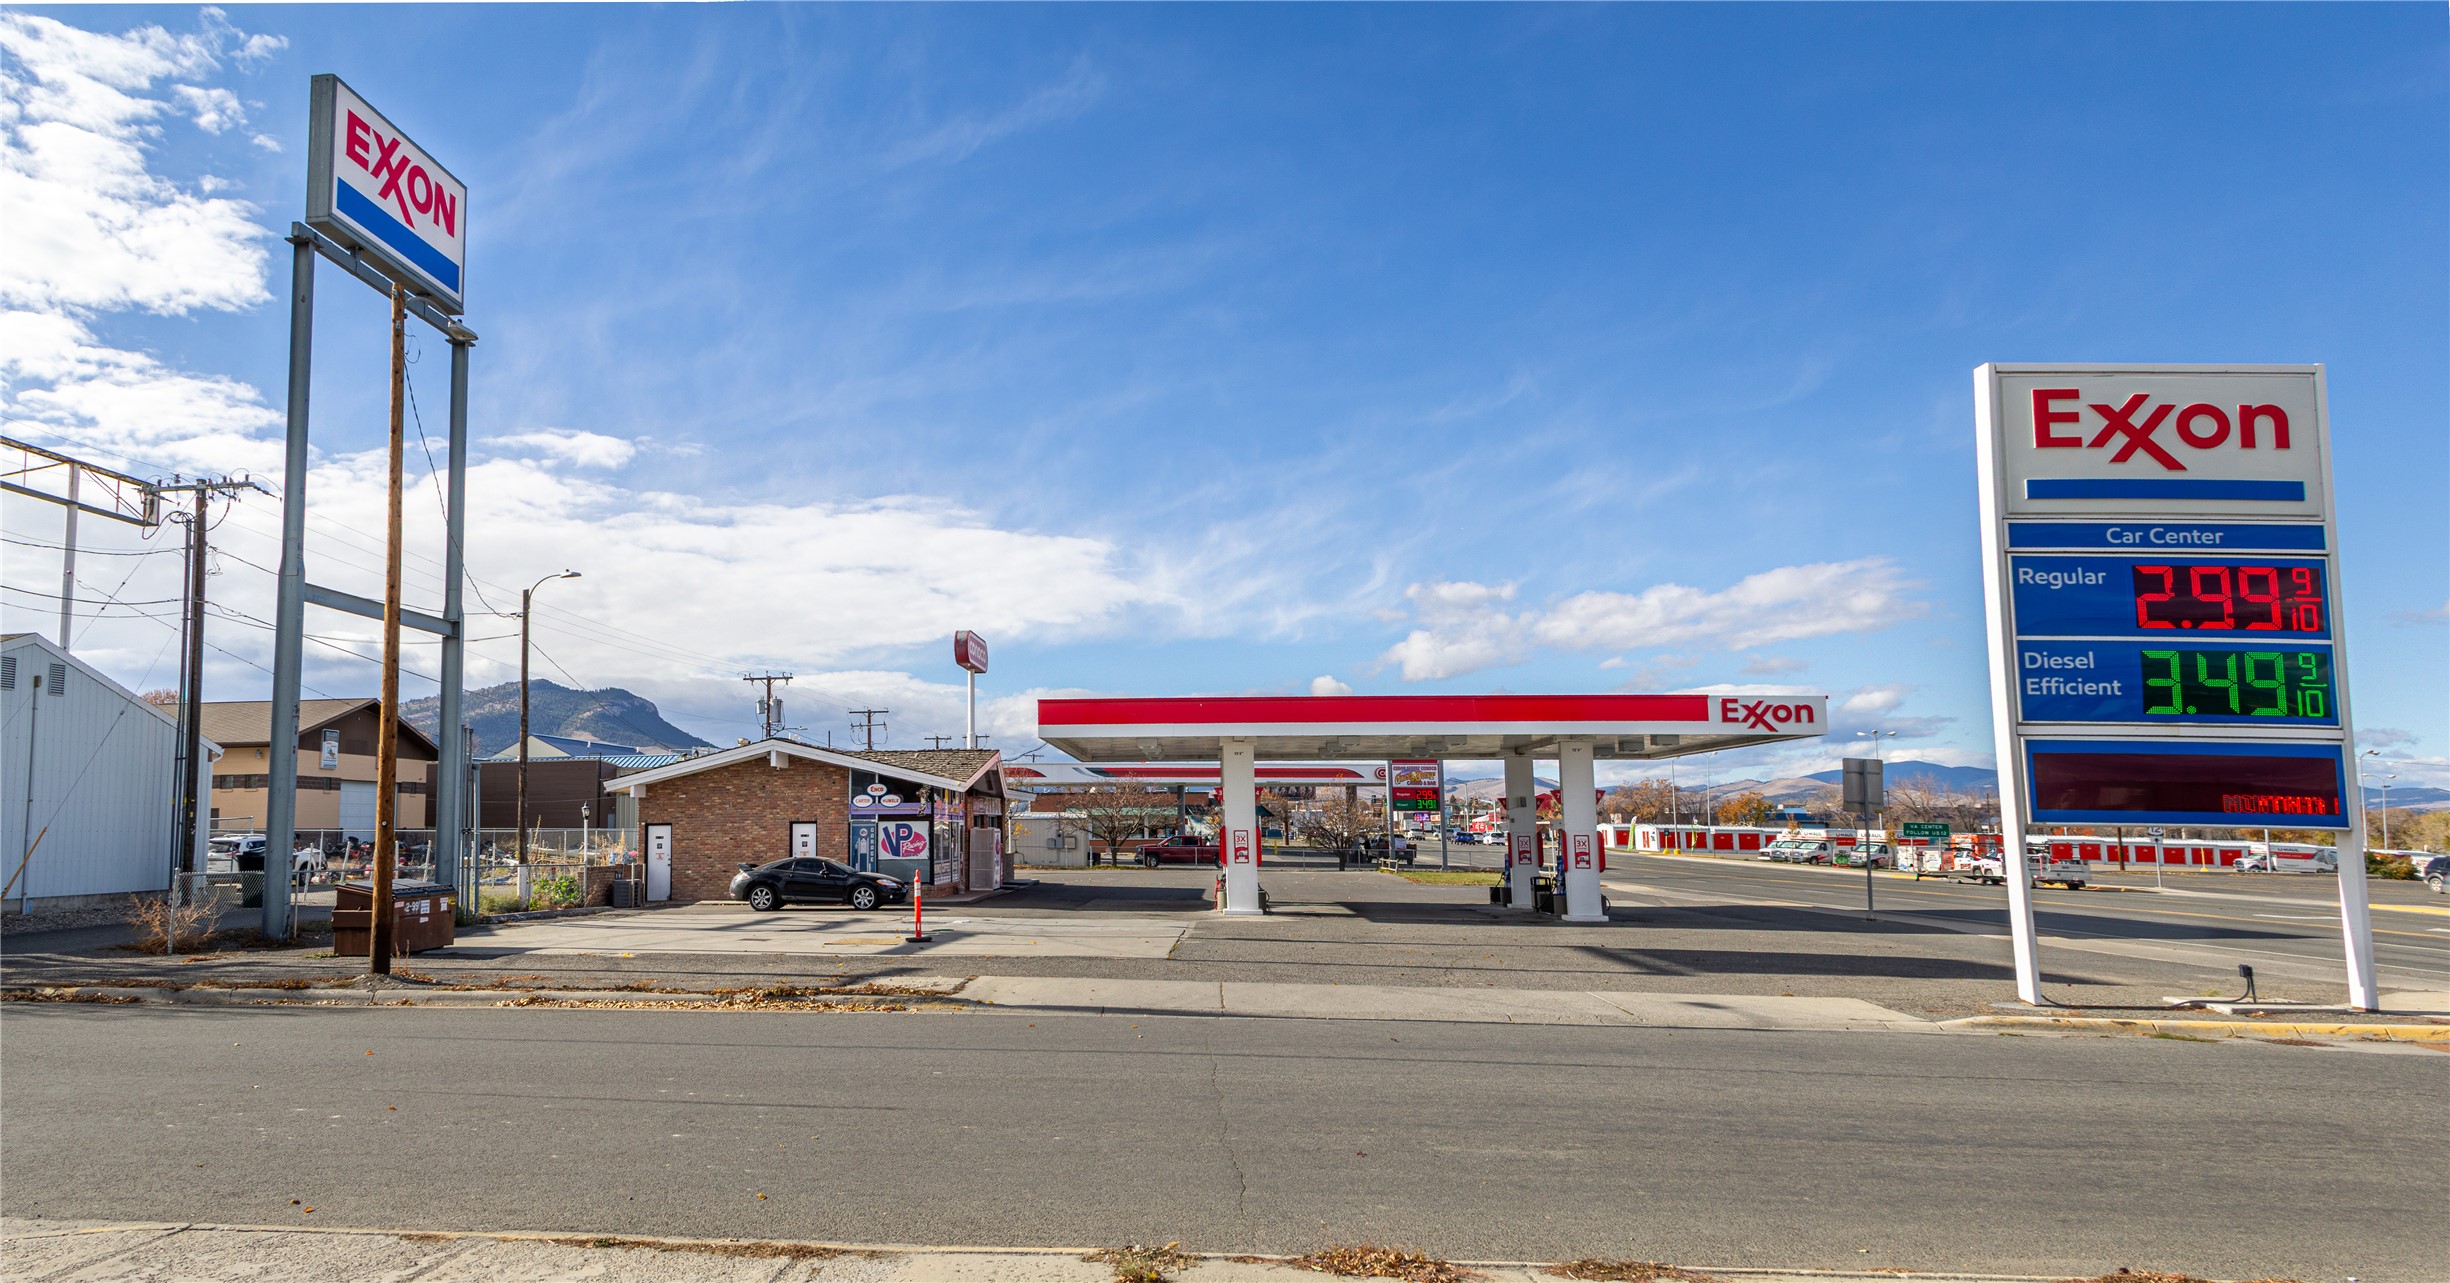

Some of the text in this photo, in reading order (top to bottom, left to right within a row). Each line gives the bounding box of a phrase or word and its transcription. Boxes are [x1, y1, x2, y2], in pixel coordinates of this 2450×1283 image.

[346, 108, 456, 238] EXXON
[2031, 388, 2290, 471] Exxon
[2106, 527, 2224, 545] Car Center
[2018, 565, 2282, 631] Regular 2.99
[2024, 651, 2095, 669] Diesel
[2142, 650, 2288, 717] 3.49
[2026, 677, 2122, 696] Efficient
[1721, 698, 1815, 732] Exxon
